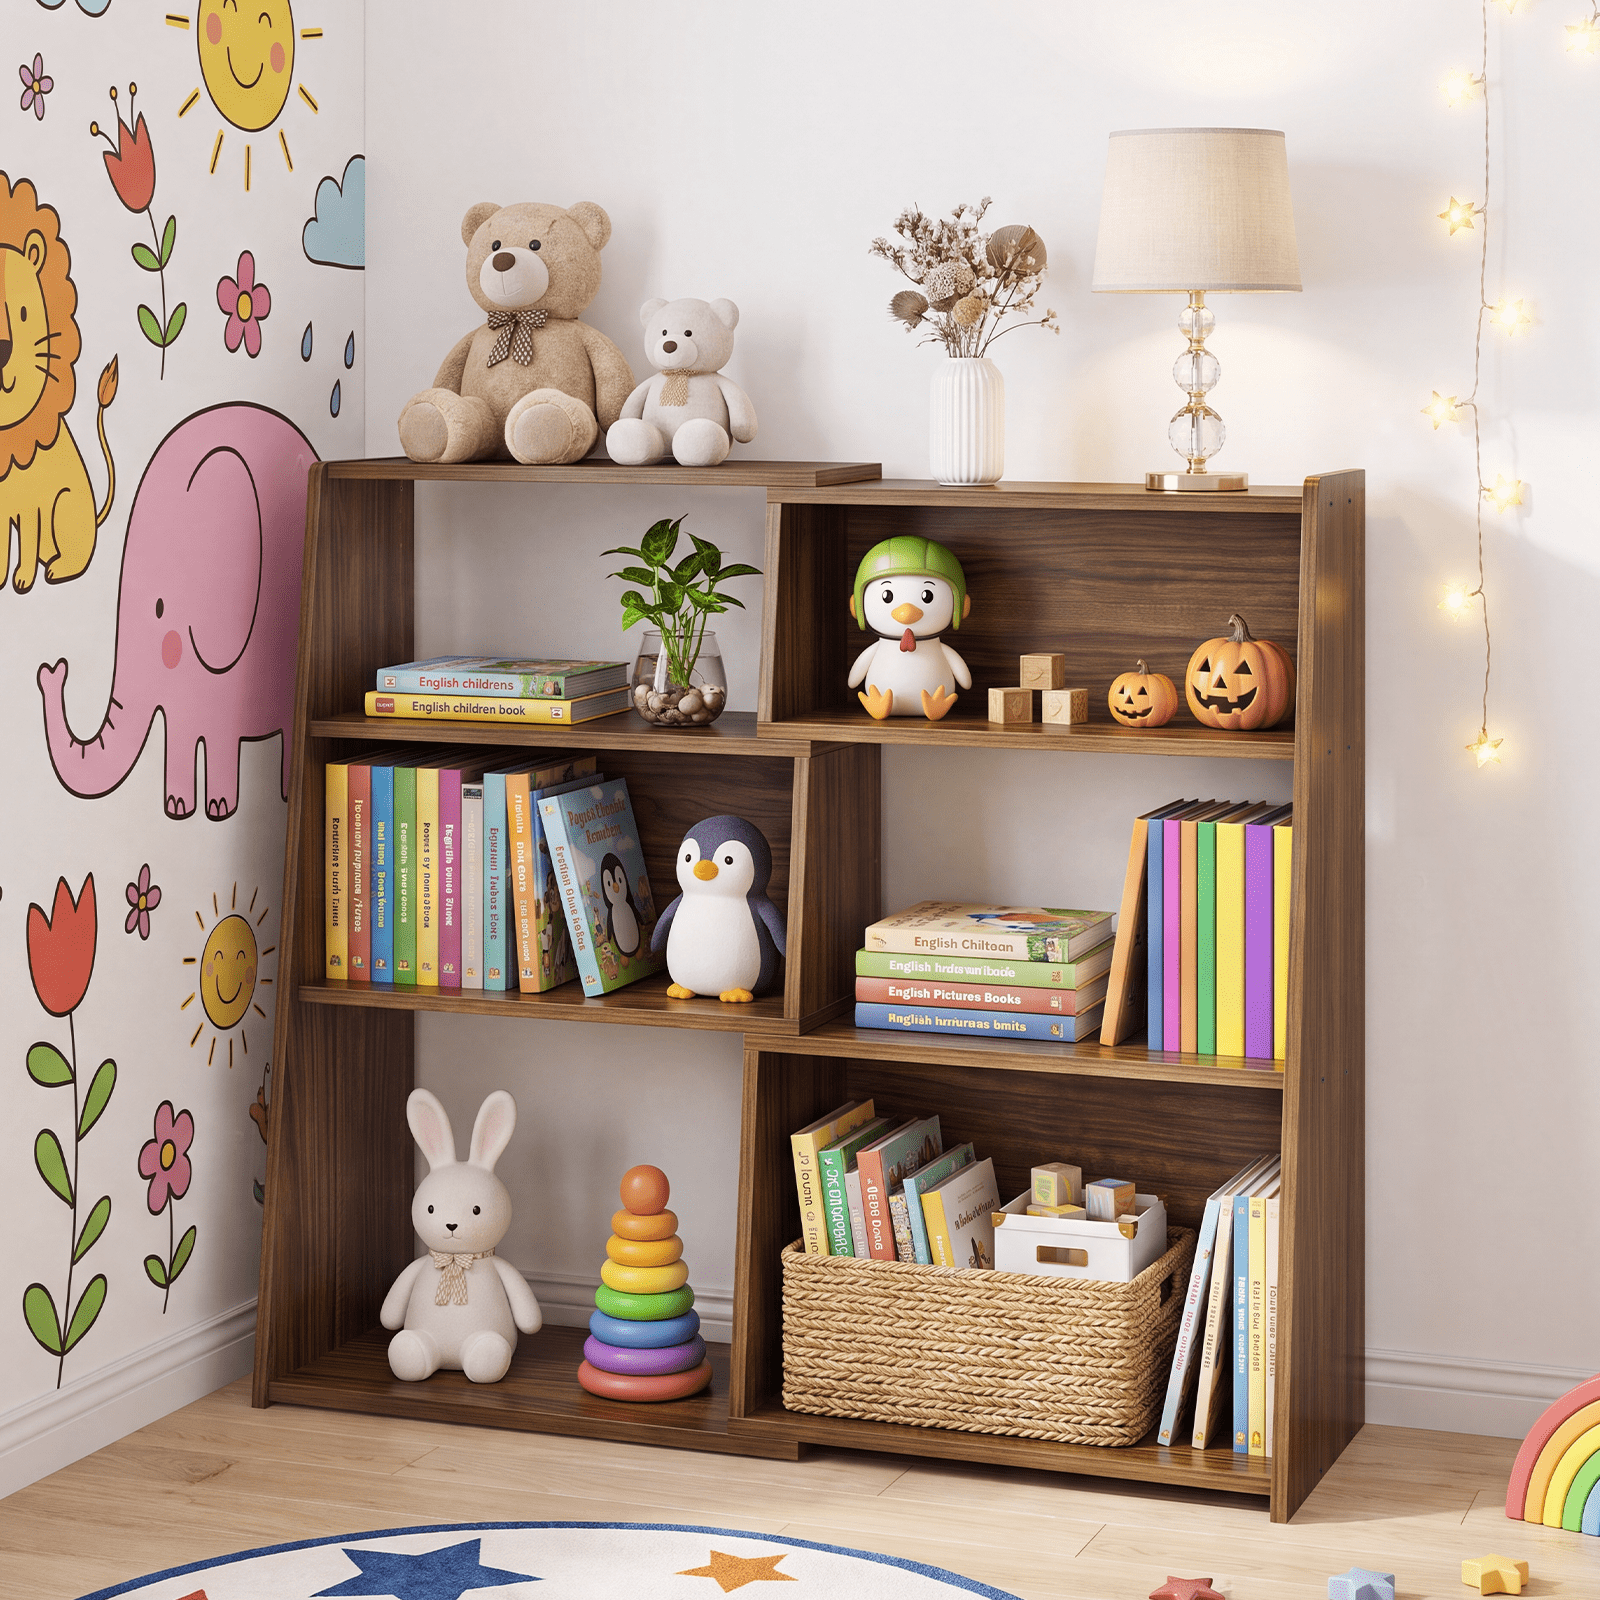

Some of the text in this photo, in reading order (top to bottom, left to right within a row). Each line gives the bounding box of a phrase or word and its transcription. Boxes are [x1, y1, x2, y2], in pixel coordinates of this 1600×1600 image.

[419, 676, 514, 691] English childrens
[412, 701, 526, 716] English children book
[914, 936, 958, 951] English
[889, 960, 931, 974] English
[888, 986, 1021, 1005] English Pictures Books
